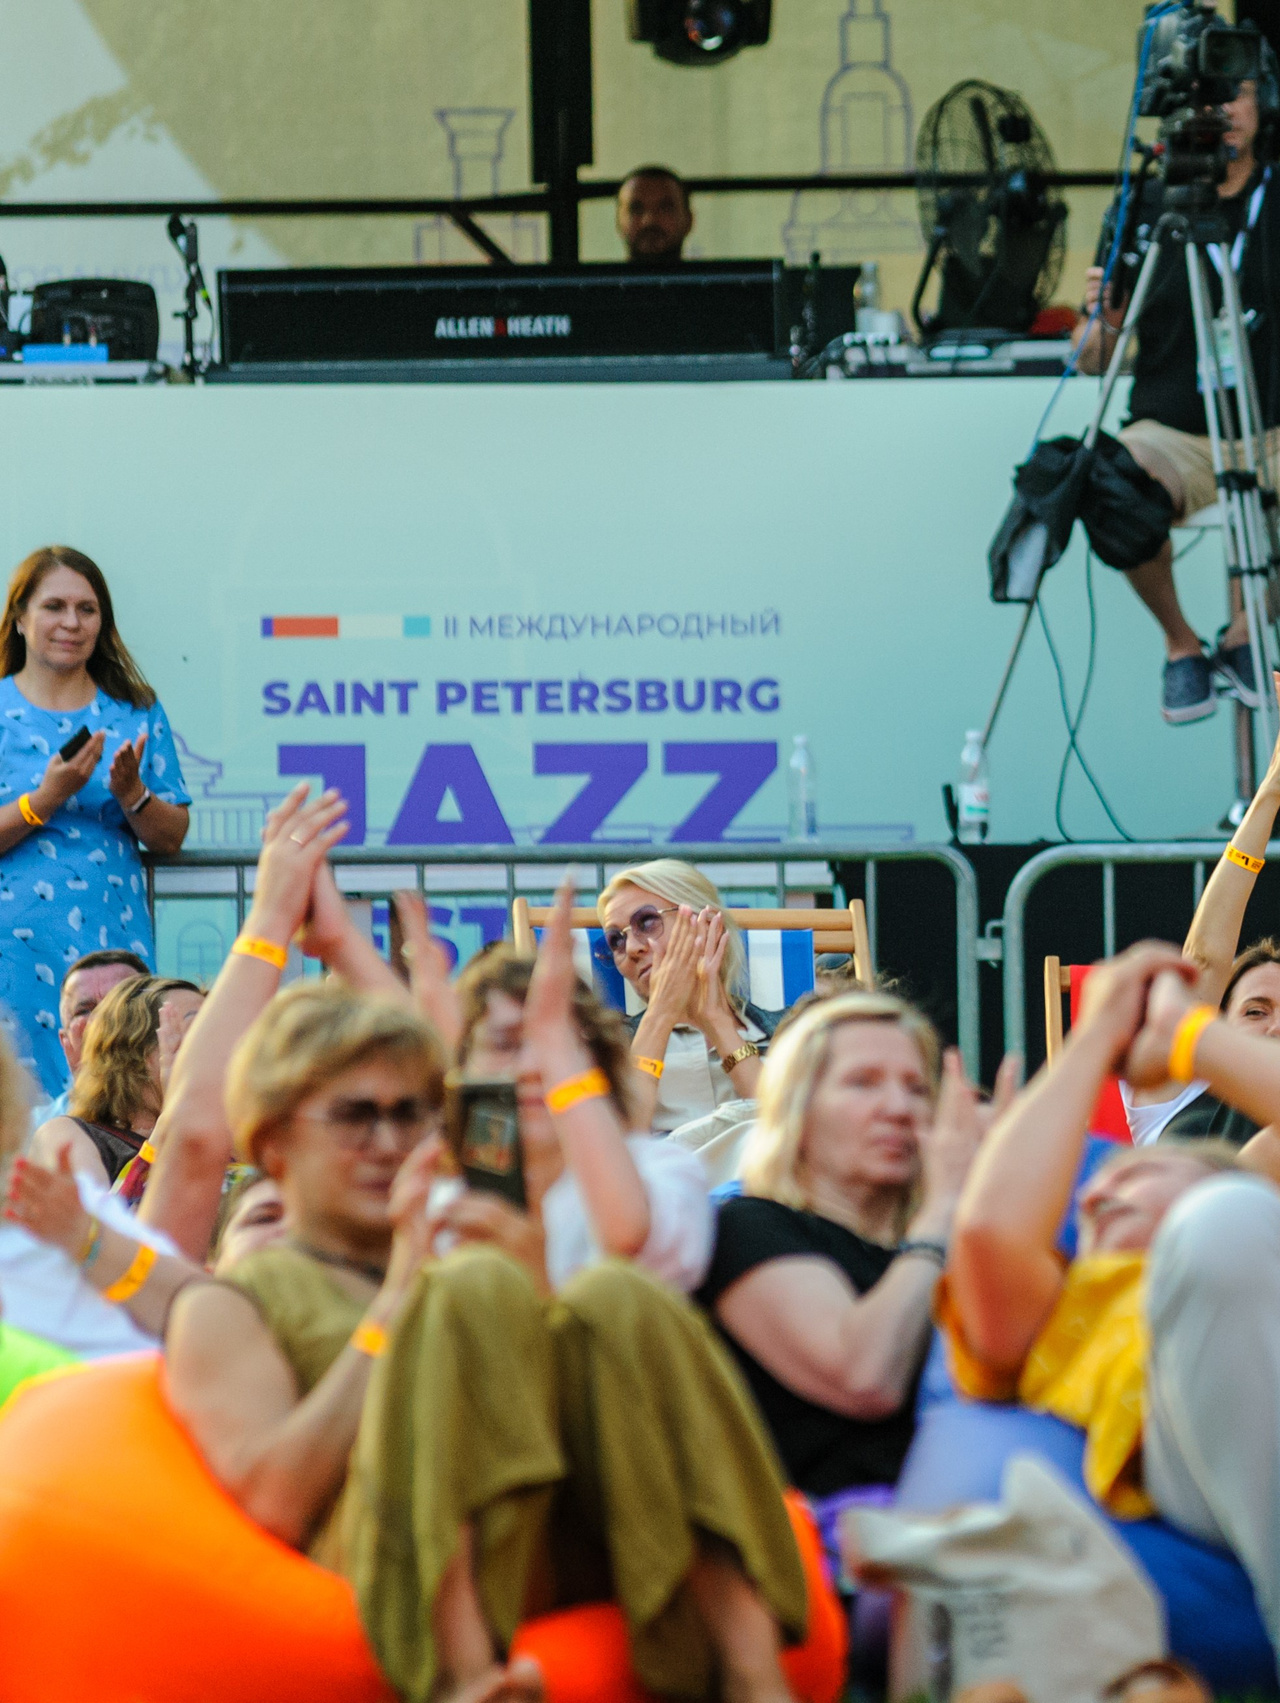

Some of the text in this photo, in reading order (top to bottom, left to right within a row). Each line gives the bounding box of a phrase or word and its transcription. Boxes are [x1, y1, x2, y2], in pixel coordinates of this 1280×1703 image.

[469, 610, 781, 641] МЕЖДУНАРОДНЫЙ
[262, 678, 781, 716] SAINT PETERSBURG
[277, 741, 778, 845] JAZZ
